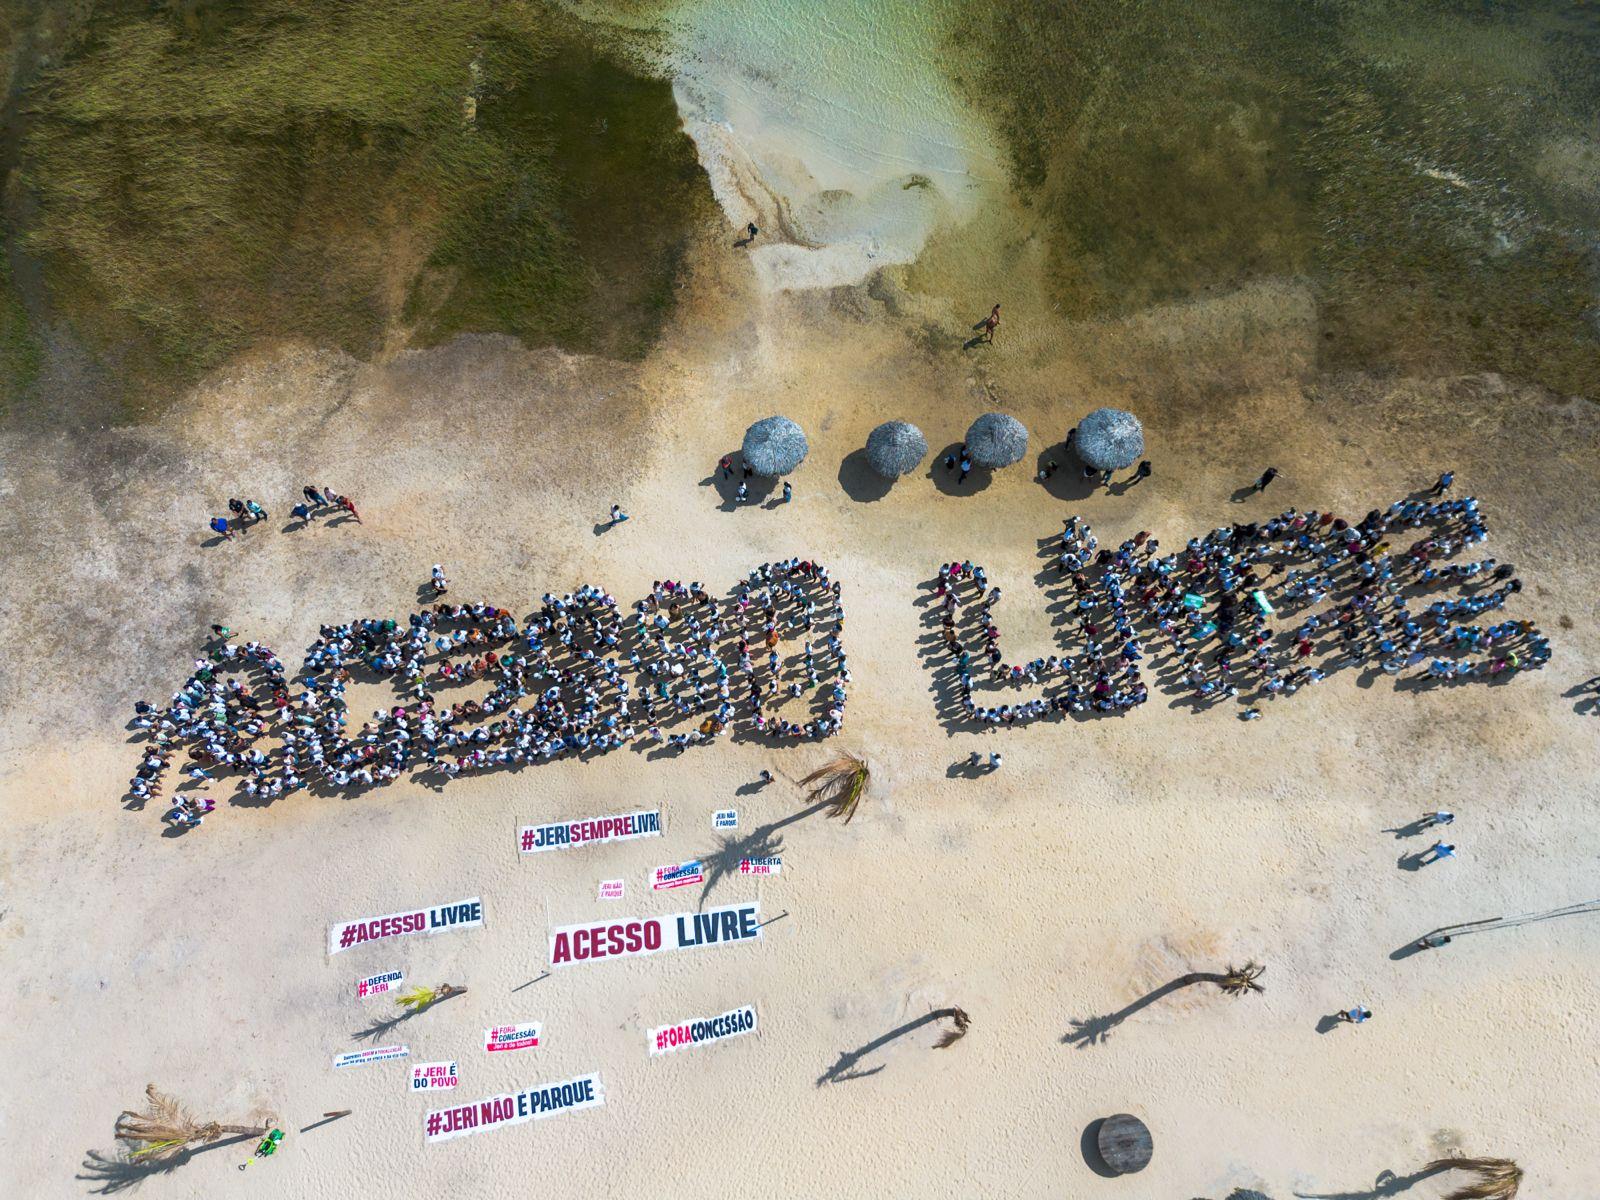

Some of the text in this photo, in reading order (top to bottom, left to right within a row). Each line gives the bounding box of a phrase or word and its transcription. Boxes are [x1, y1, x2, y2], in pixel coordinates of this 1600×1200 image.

[751, 865, 770, 874] JERI
[339, 902, 481, 948] #ACESSO LIVRE
[552, 907, 758, 964] ACESSO LIVRE
[369, 983, 389, 995] JERI
[423, 1066, 447, 1078] JERI
[449, 1062, 456, 1076] É
[414, 1076, 458, 1089] DO POVO
[427, 1079, 595, 1137] #JERI NÃO É PARQUE
